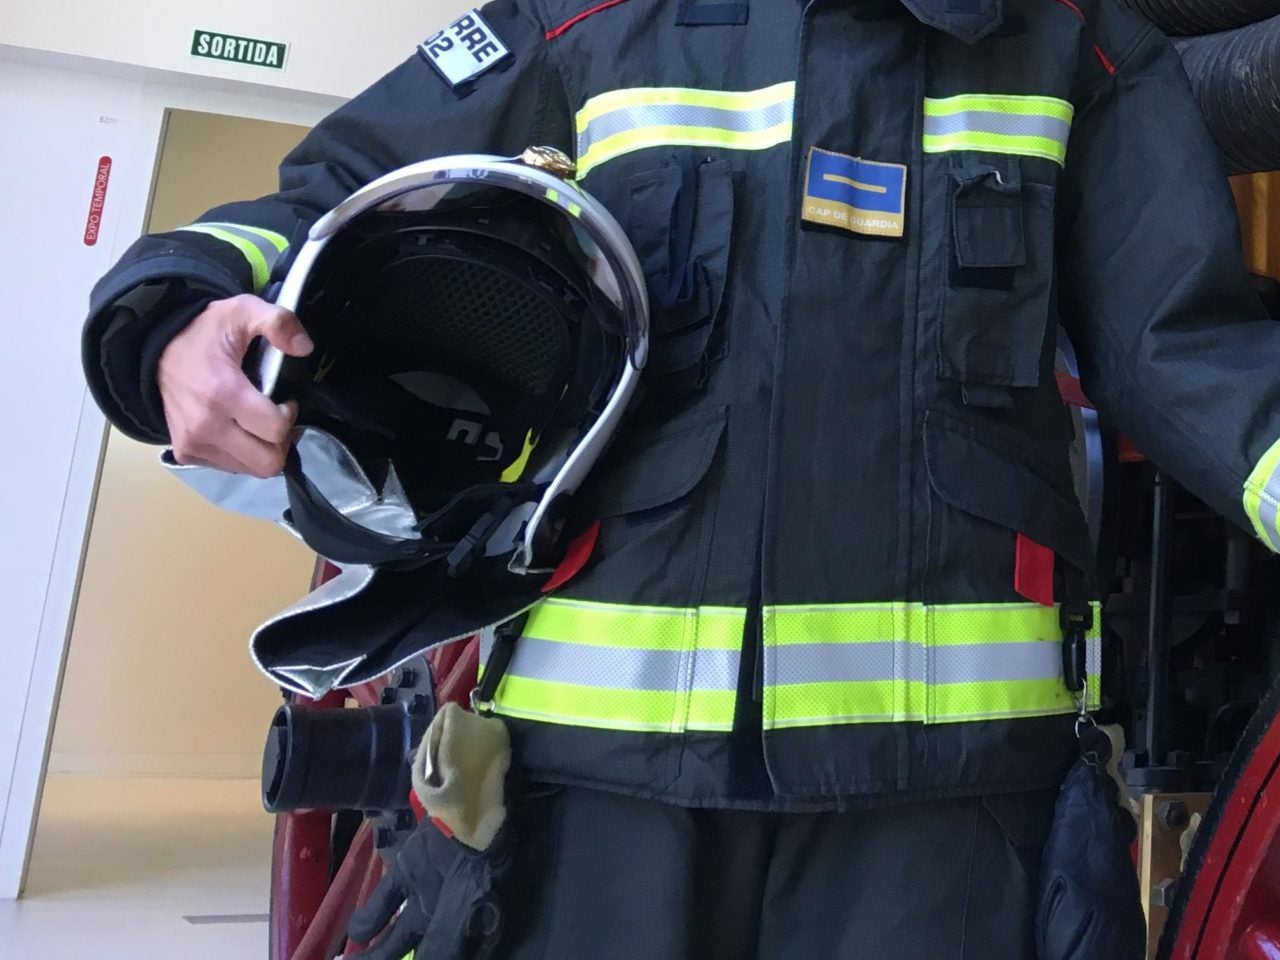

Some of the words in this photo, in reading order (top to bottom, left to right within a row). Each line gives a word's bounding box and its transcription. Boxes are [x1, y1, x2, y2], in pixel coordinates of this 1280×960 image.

[197, 33, 278, 66] SORTIDA
[450, 15, 499, 63] RRE
[91, 163, 110, 212] TEMPORAL
[86, 215, 99, 240] EXPO
[808, 206, 832, 219] CAP
[833, 211, 849, 221] DE
[850, 216, 898, 229] GUARDIA
